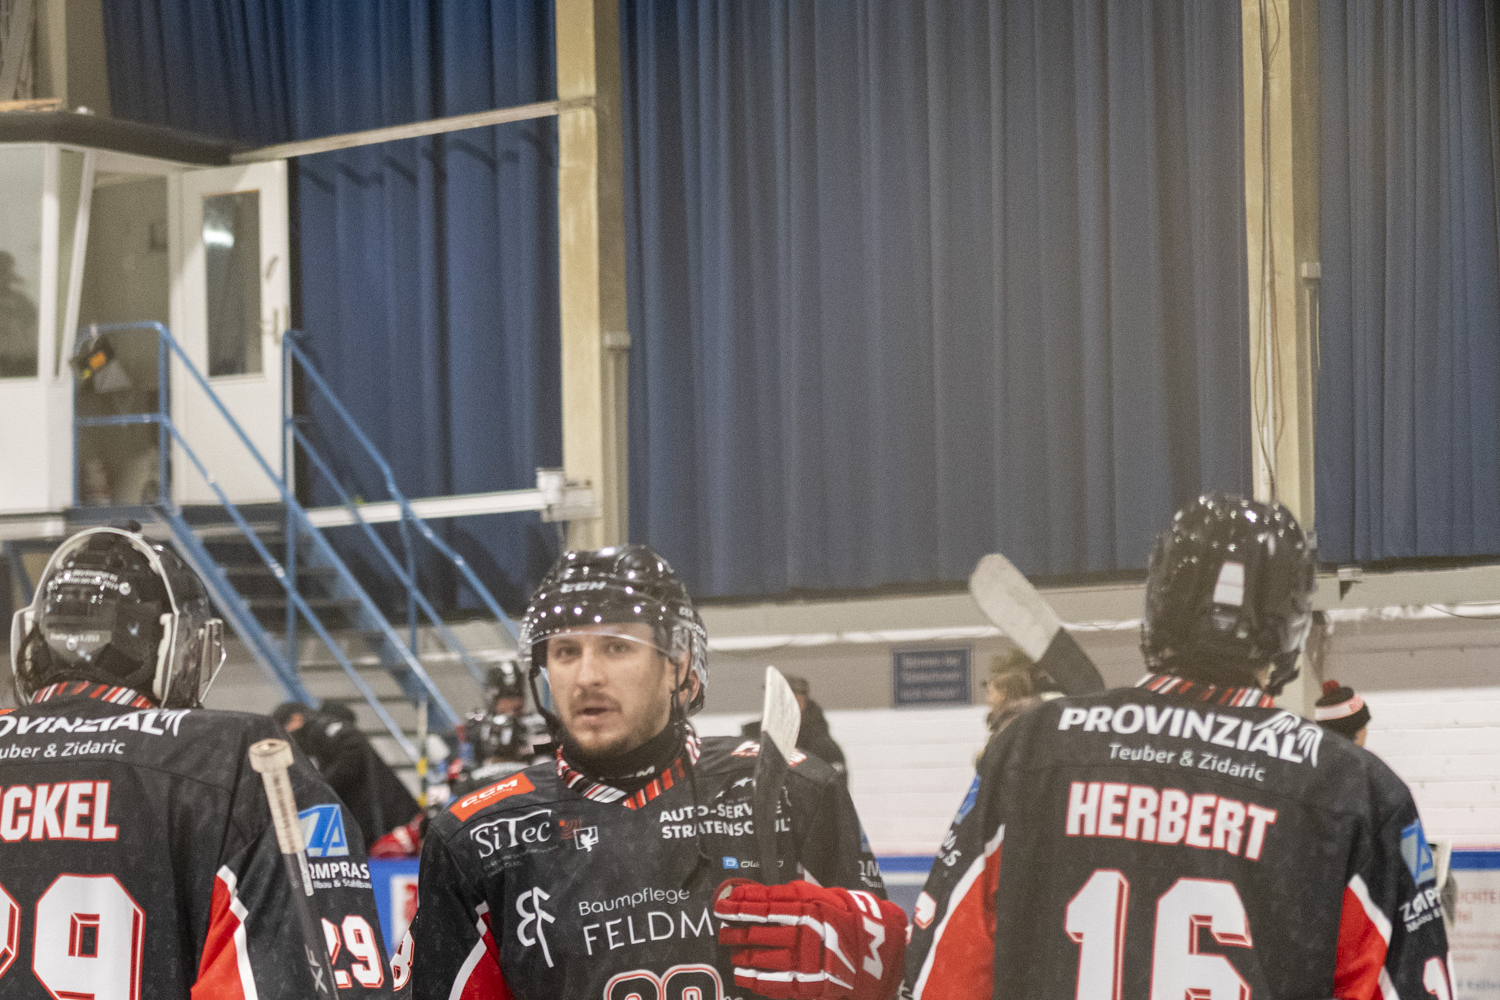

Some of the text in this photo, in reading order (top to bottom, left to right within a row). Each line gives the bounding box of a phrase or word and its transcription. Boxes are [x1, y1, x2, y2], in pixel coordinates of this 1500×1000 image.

[43, 743, 57, 758] &
[61, 739, 126, 758] Zidaric
[1058, 703, 1304, 764] PROVINZIAL
[1108, 742, 1266, 782] Teuber & Zidaric
[461, 778, 518, 809] CCM
[1065, 781, 1278, 861] HERBERT
[578, 886, 691, 917] Baumpflege
